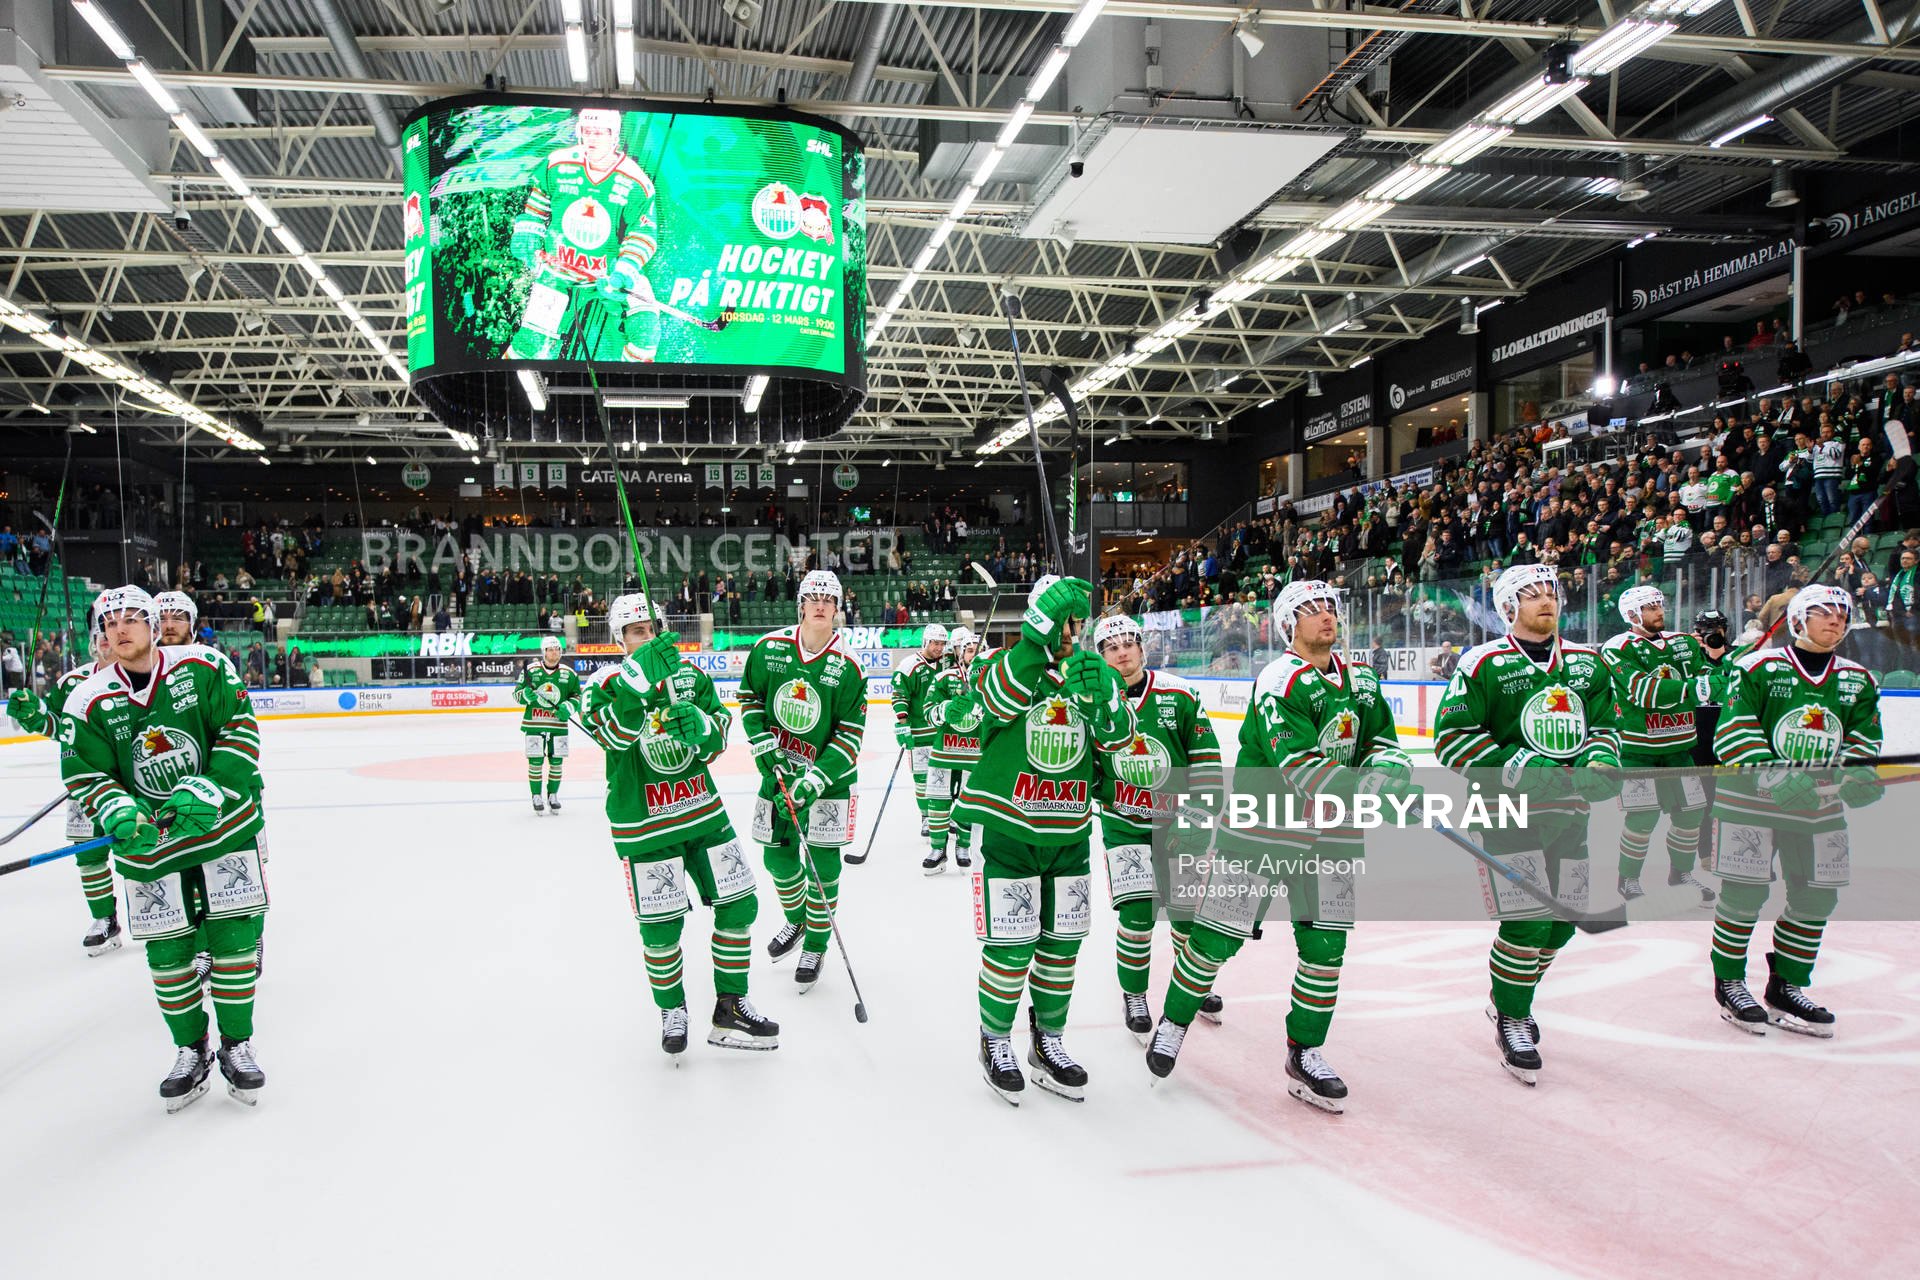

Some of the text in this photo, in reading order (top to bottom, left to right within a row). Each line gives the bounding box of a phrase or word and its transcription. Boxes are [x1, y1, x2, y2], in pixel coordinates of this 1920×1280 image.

[806, 139, 832, 158] SHL
[1853, 214, 1860, 230] I
[717, 244, 835, 280] HOCKEY
[1650, 238, 1797, 305] BÄST PÅ HEMMAPLAN
[668, 269, 835, 315] PÅ RIKTIGT
[721, 311, 835, 330] TORSDAG 12 MARS 19:00
[501, 469, 506, 480] 1
[527, 468, 534, 480] 9
[551, 469, 563, 480] 13
[581, 469, 693, 485] CATENA Arena
[708, 469, 720, 481] 19
[734, 469, 747, 481] 25
[760, 469, 773, 481] 26
[709, 531, 899, 572] CENTER
[420, 632, 475, 656] RBK
[1682, 660, 1694, 679] C
[359, 691, 392, 700] Resurs
[360, 701, 383, 710] Bank
[1646, 710, 1695, 730] MAXI
[1533, 714, 1582, 751] RÖGLE
[1030, 727, 1080, 766] RÖGLE
[1783, 730, 1836, 760] RÖGLE
[138, 751, 195, 792] RÖGLE
[1120, 757, 1162, 787] RÖGLE
[645, 773, 706, 808] MAXI
[1013, 772, 1087, 803] MAXI
[1114, 780, 1179, 812] MAXI
[663, 793, 712, 813] STORMARKNAD
[1025, 801, 1086, 812] STORMARKNAD
[1720, 855, 1769, 865] PEUGEOT
[210, 885, 262, 899] PEUGEOT
[641, 890, 686, 902] PEUGEOT
[131, 909, 182, 922] PEUGEOT
[1207, 898, 1254, 918] PEUGEOT
[132, 916, 185, 929] MOTOR VILLAGE
